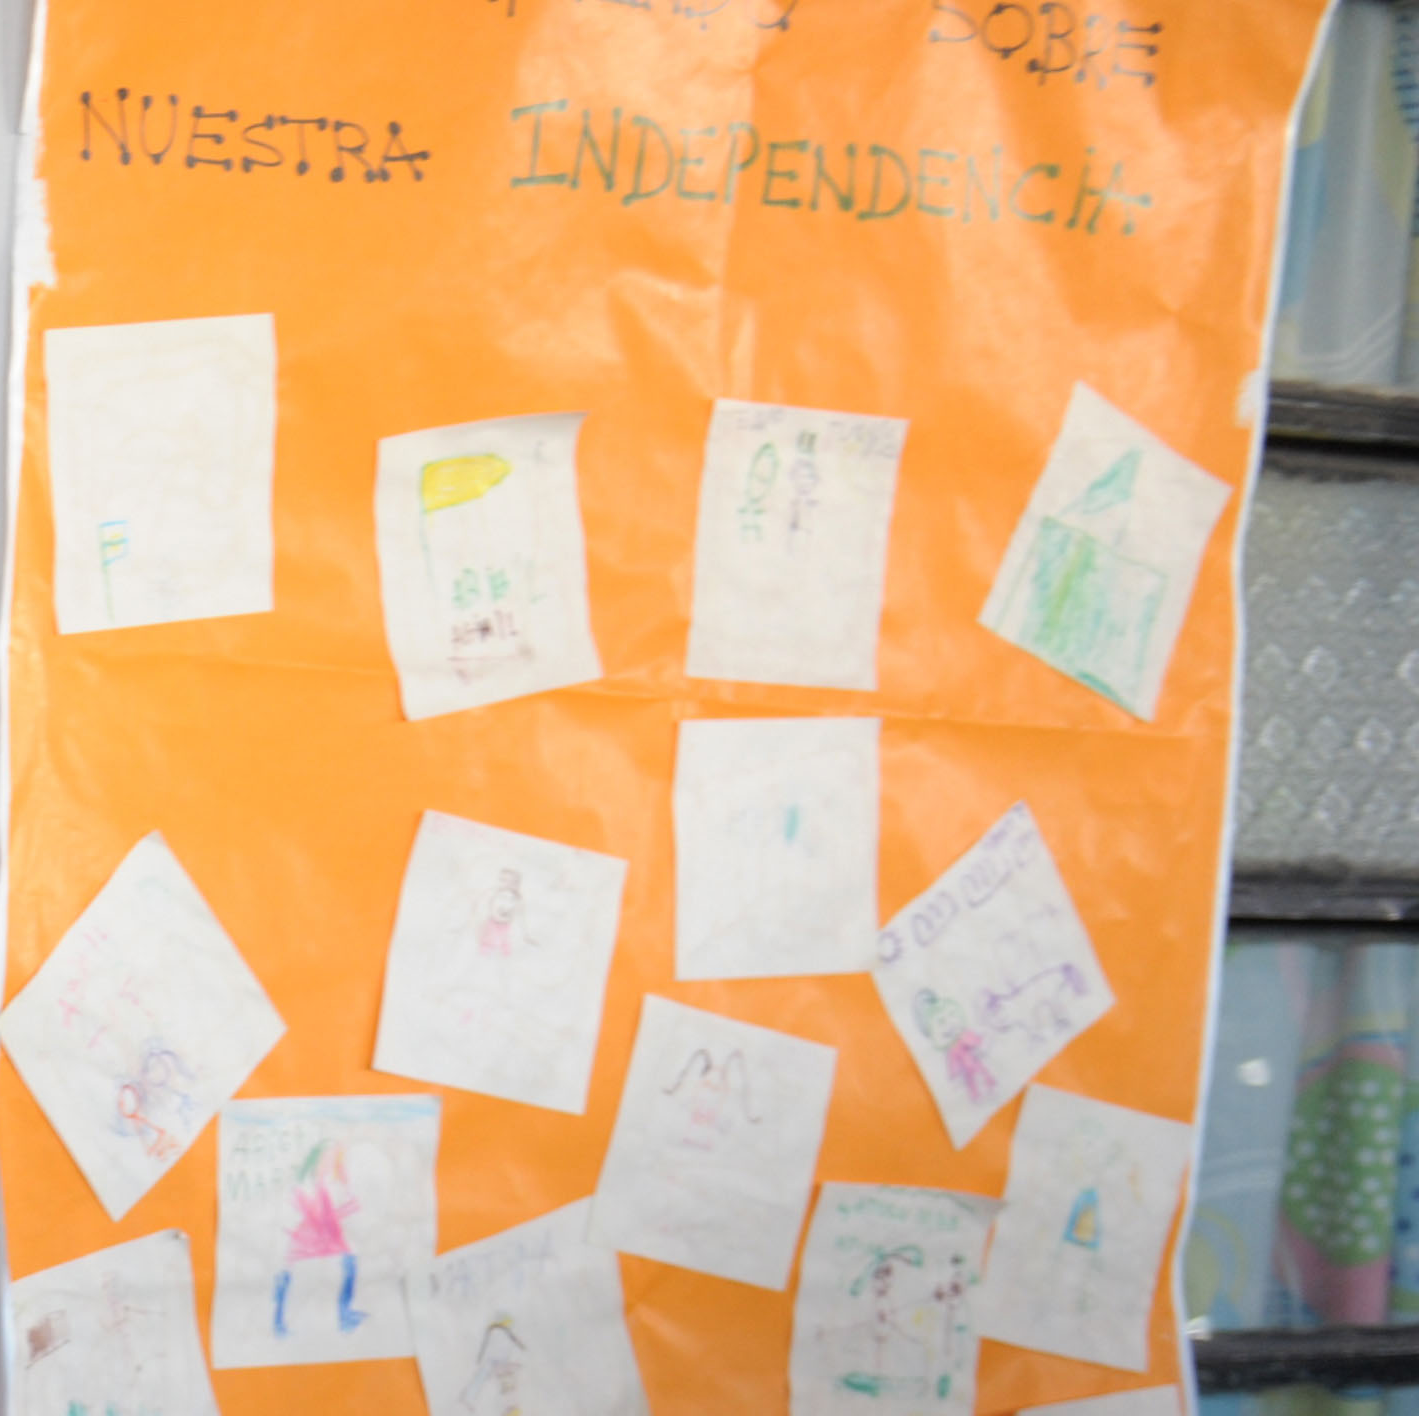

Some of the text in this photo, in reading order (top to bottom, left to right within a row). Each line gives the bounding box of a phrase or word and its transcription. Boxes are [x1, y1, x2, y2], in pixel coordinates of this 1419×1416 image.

[928, 0, 1162, 89] SOBRE
[80, 87, 1152, 235] NUESTRA INDEPENDENCIA
